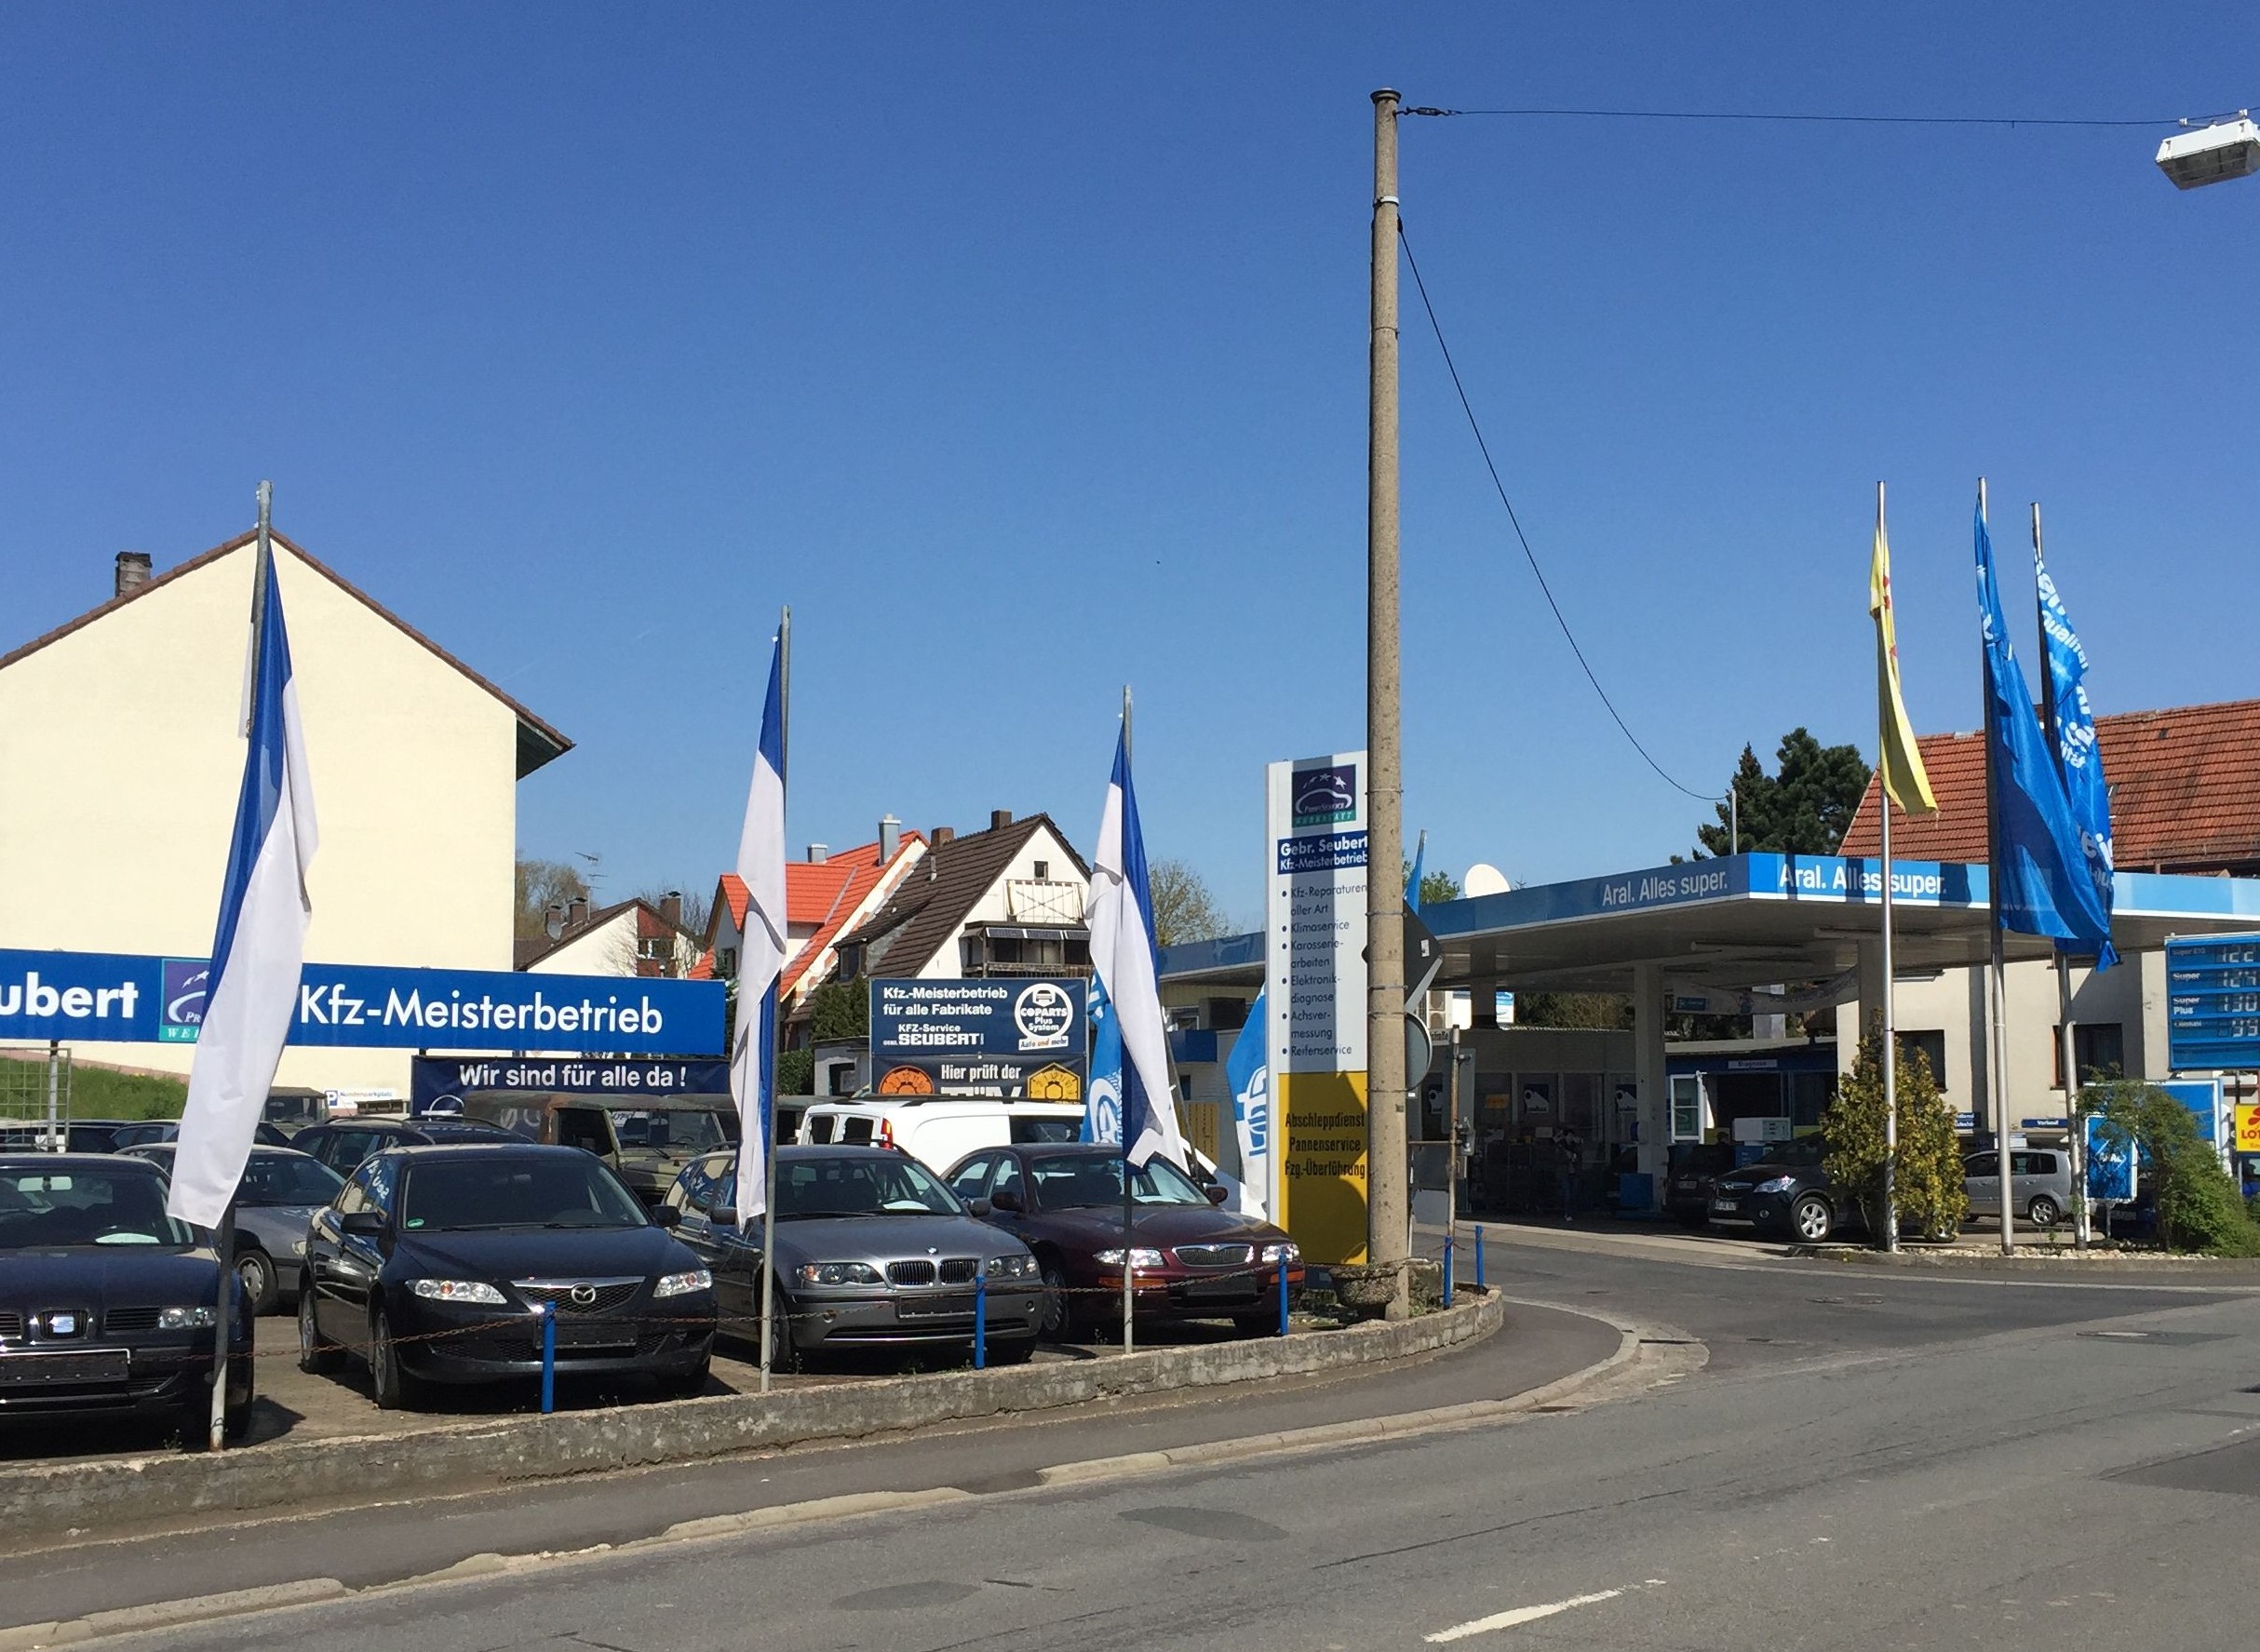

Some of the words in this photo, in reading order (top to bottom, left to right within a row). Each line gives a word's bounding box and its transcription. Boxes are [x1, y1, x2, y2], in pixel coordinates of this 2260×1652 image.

[1280, 841, 1314, 856] Gebr.
[1603, 880, 1634, 907] Aral.
[1639, 876, 1676, 902] Alles
[1680, 870, 1728, 896] super.
[1780, 864, 1826, 889] Aral.
[1834, 865, 1881, 891] Alles
[1890, 874, 1947, 900] super.
[1291, 884, 1367, 899] Kfz-Reparaturen
[1291, 906, 1312, 916] aller
[1314, 904, 1328, 914] Art
[1291, 920, 1350, 933] Klimaservice
[1291, 940, 1343, 951] Karosserie-
[1291, 957, 1330, 969] arbeiten
[1291, 974, 1340, 987] Elektronik-
[2173, 973, 2200, 981] Super
[883, 987, 1008, 1000] Kfz.-Meisterbetrieb
[1291, 992, 1334, 1005] diagnose
[0, 972, 139, 1019] ubert
[300, 984, 663, 1034] Kfz-Meisterbetrieb
[2173, 997, 2200, 1005] Super
[883, 1003, 903, 1015] für
[906, 1003, 929, 1015] alle
[932, 1003, 993, 1015] Fabrikate
[1020, 1007, 1068, 1017] COPARTS
[2173, 1006, 2194, 1015] Plus
[1034, 1016, 1053, 1025] Plus
[1291, 1011, 1331, 1021] Achsver-
[898, 1024, 962, 1032] KFZ-Service
[1028, 1023, 1059, 1032] System
[898, 1033, 980, 1045] SEUBERT
[1291, 1028, 1333, 1041] messung
[1291, 1044, 1352, 1056] Reifenservice
[459, 1064, 498, 1086] Wir
[505, 1065, 557, 1087] sind
[561, 1064, 596, 1086] für
[601, 1065, 640, 1087] alle
[646, 1066, 674, 1088] da
[680, 1067, 687, 1087] !
[941, 1064, 966, 1080] Hier
[969, 1064, 999, 1082] prüft
[1001, 1064, 1022, 1080] der
[1285, 1112, 1365, 1131] Abschleppdienst
[1289, 1137, 1361, 1152] Pannenservice
[1285, 1158, 1365, 1179] Fzg.-Überführung
